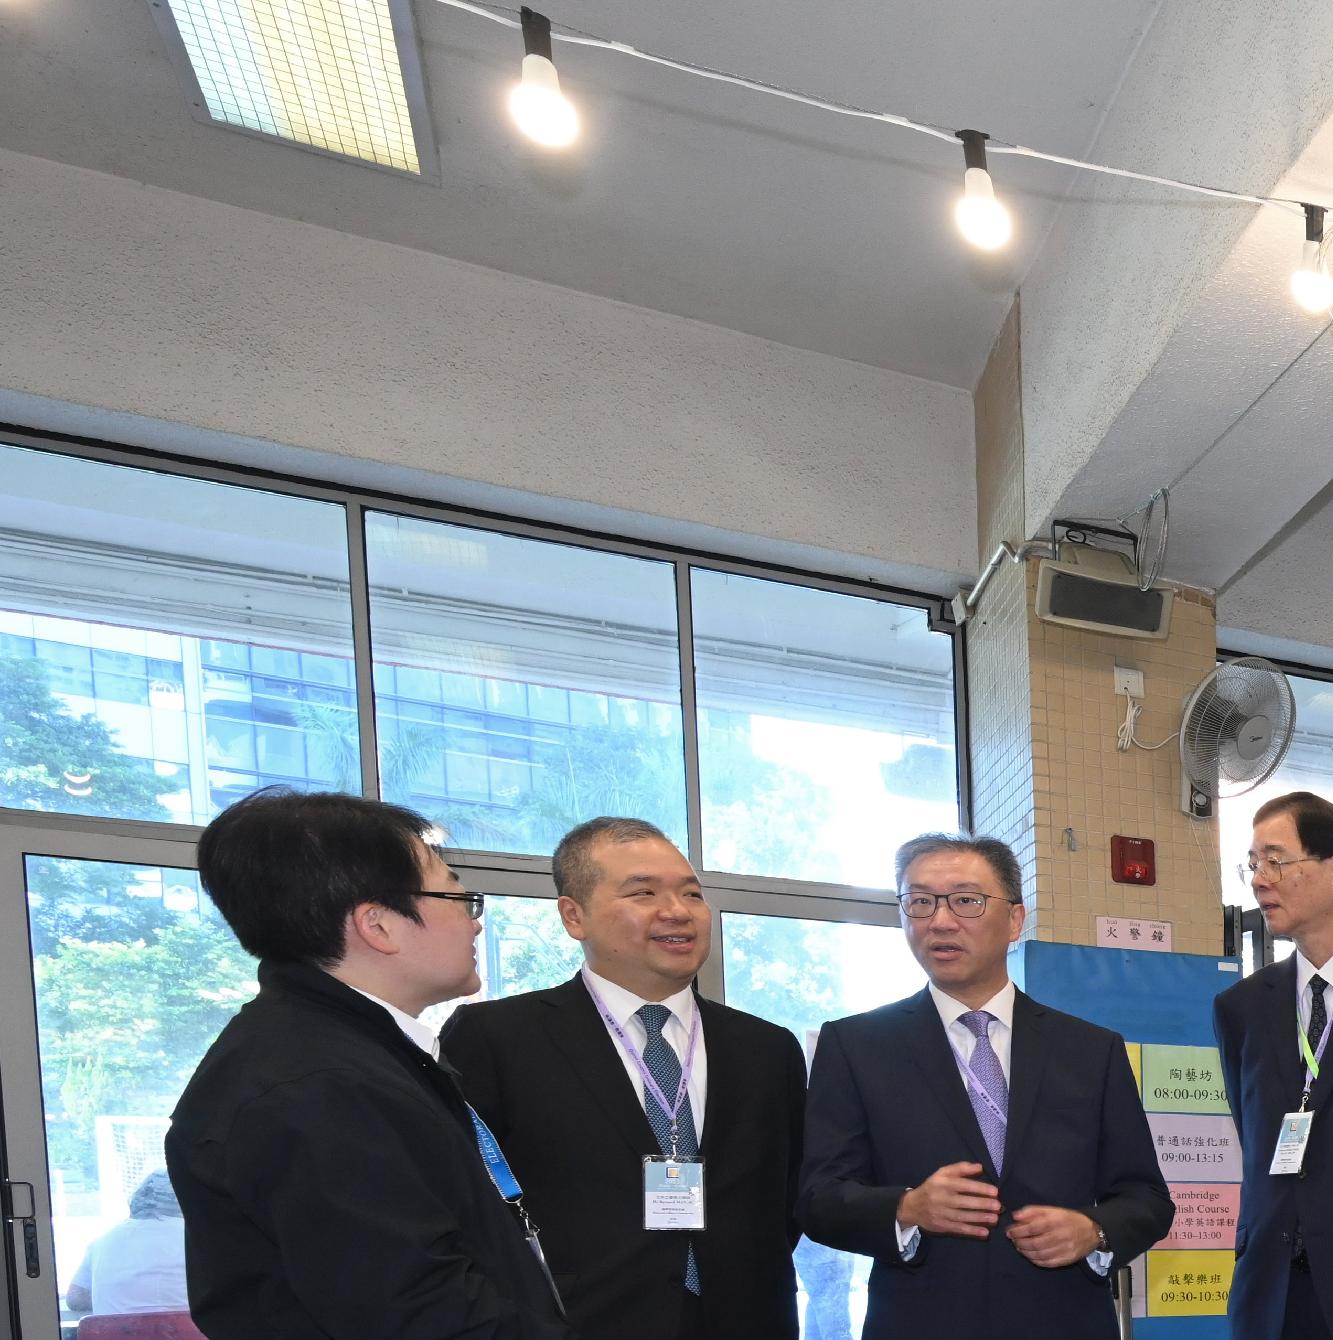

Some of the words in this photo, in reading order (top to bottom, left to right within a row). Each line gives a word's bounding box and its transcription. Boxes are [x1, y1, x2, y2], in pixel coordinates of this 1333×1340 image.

[1154, 1087, 1227, 1101] 08:00-09:30
[1161, 1152, 1224, 1163] 09:00-13:15
[1169, 1190, 1220, 1200] Cambridge
[1197, 1204, 1230, 1214] Course
[1161, 1291, 1228, 1303] 09:30-10:30
